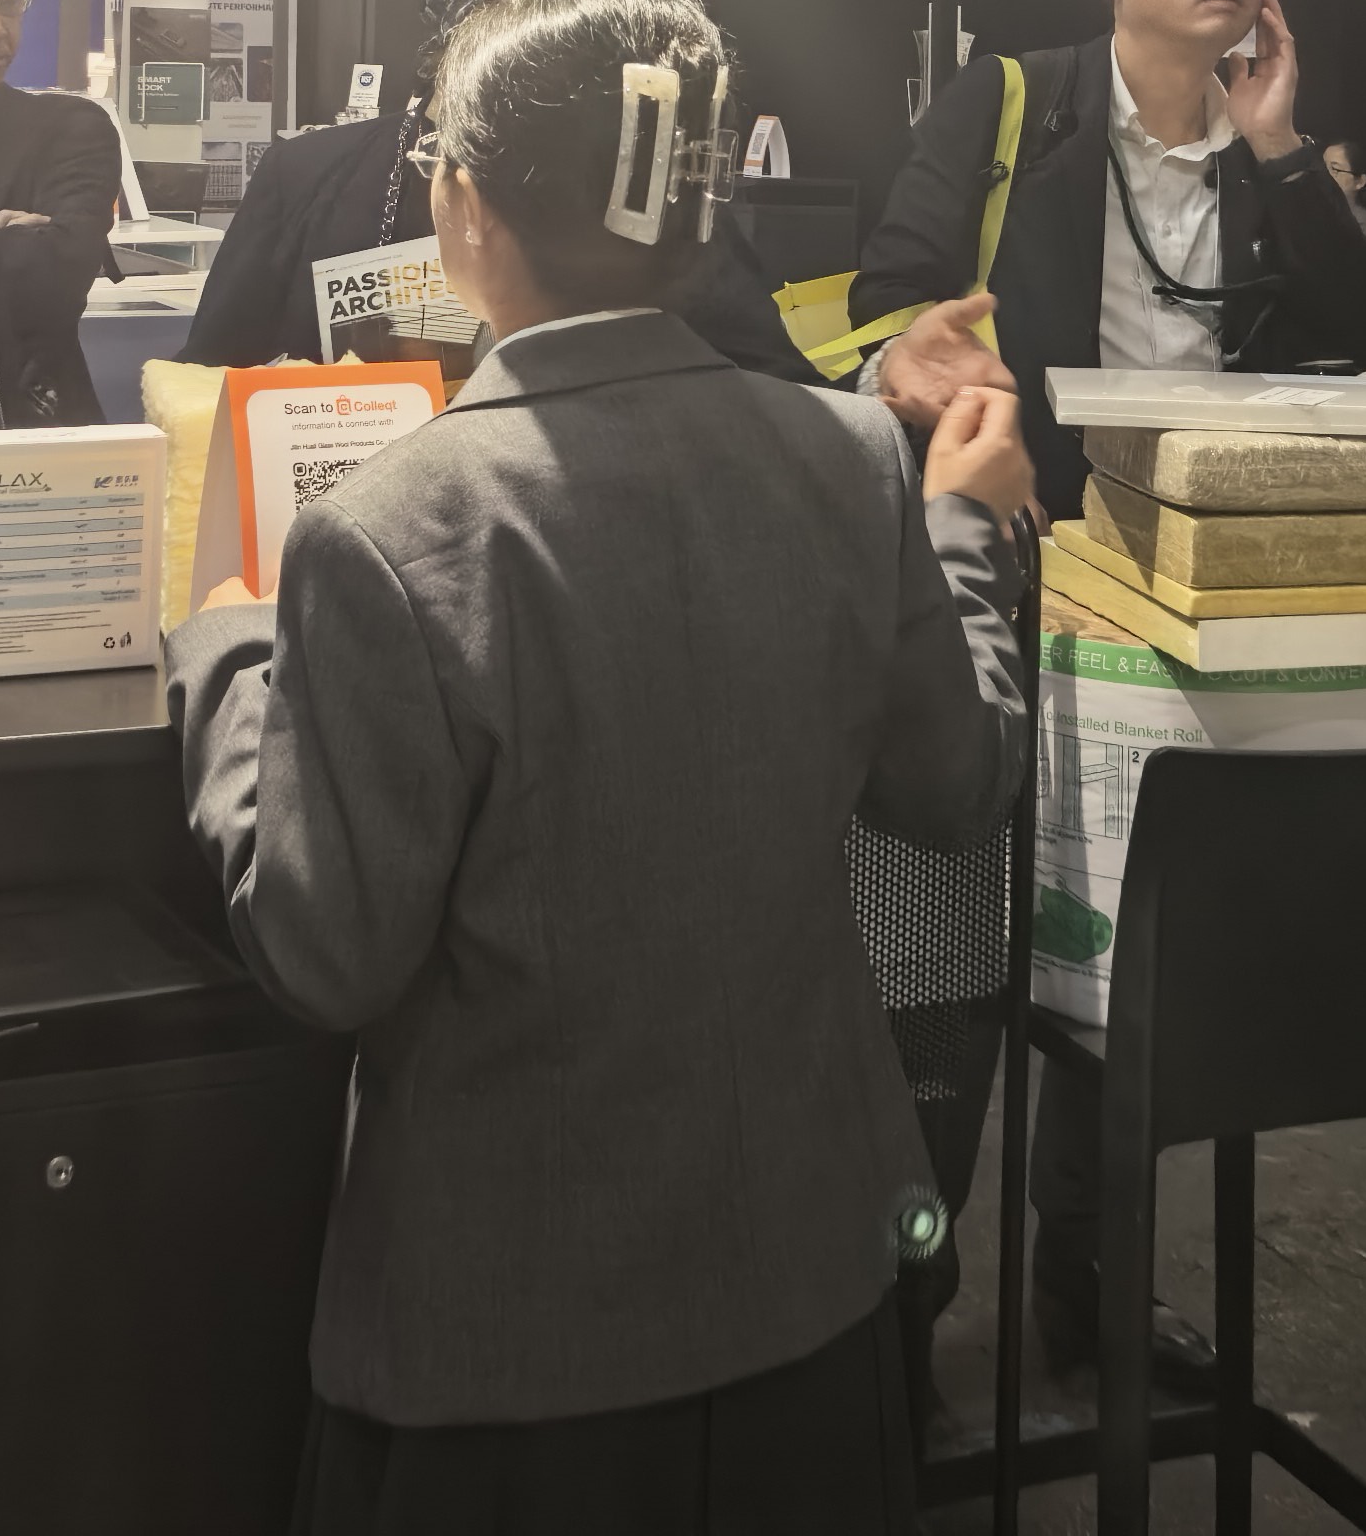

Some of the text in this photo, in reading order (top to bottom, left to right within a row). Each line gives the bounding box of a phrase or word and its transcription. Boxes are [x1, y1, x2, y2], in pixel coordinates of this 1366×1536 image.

[137, 76, 172, 84] SMART
[327, 258, 441, 299] PASSION
[285, 400, 397, 415] Scan to Colleqt
[292, 421, 336, 431] information
[346, 418, 376, 428] connect
[378, 418, 394, 426] with
[350, 440, 375, 448] Products
[1068, 650, 1111, 671] FEEL
[1118, 656, 1130, 673] &
[1056, 713, 1203, 743] Installed Blanket Roll
[1132, 751, 1140, 763] 2
